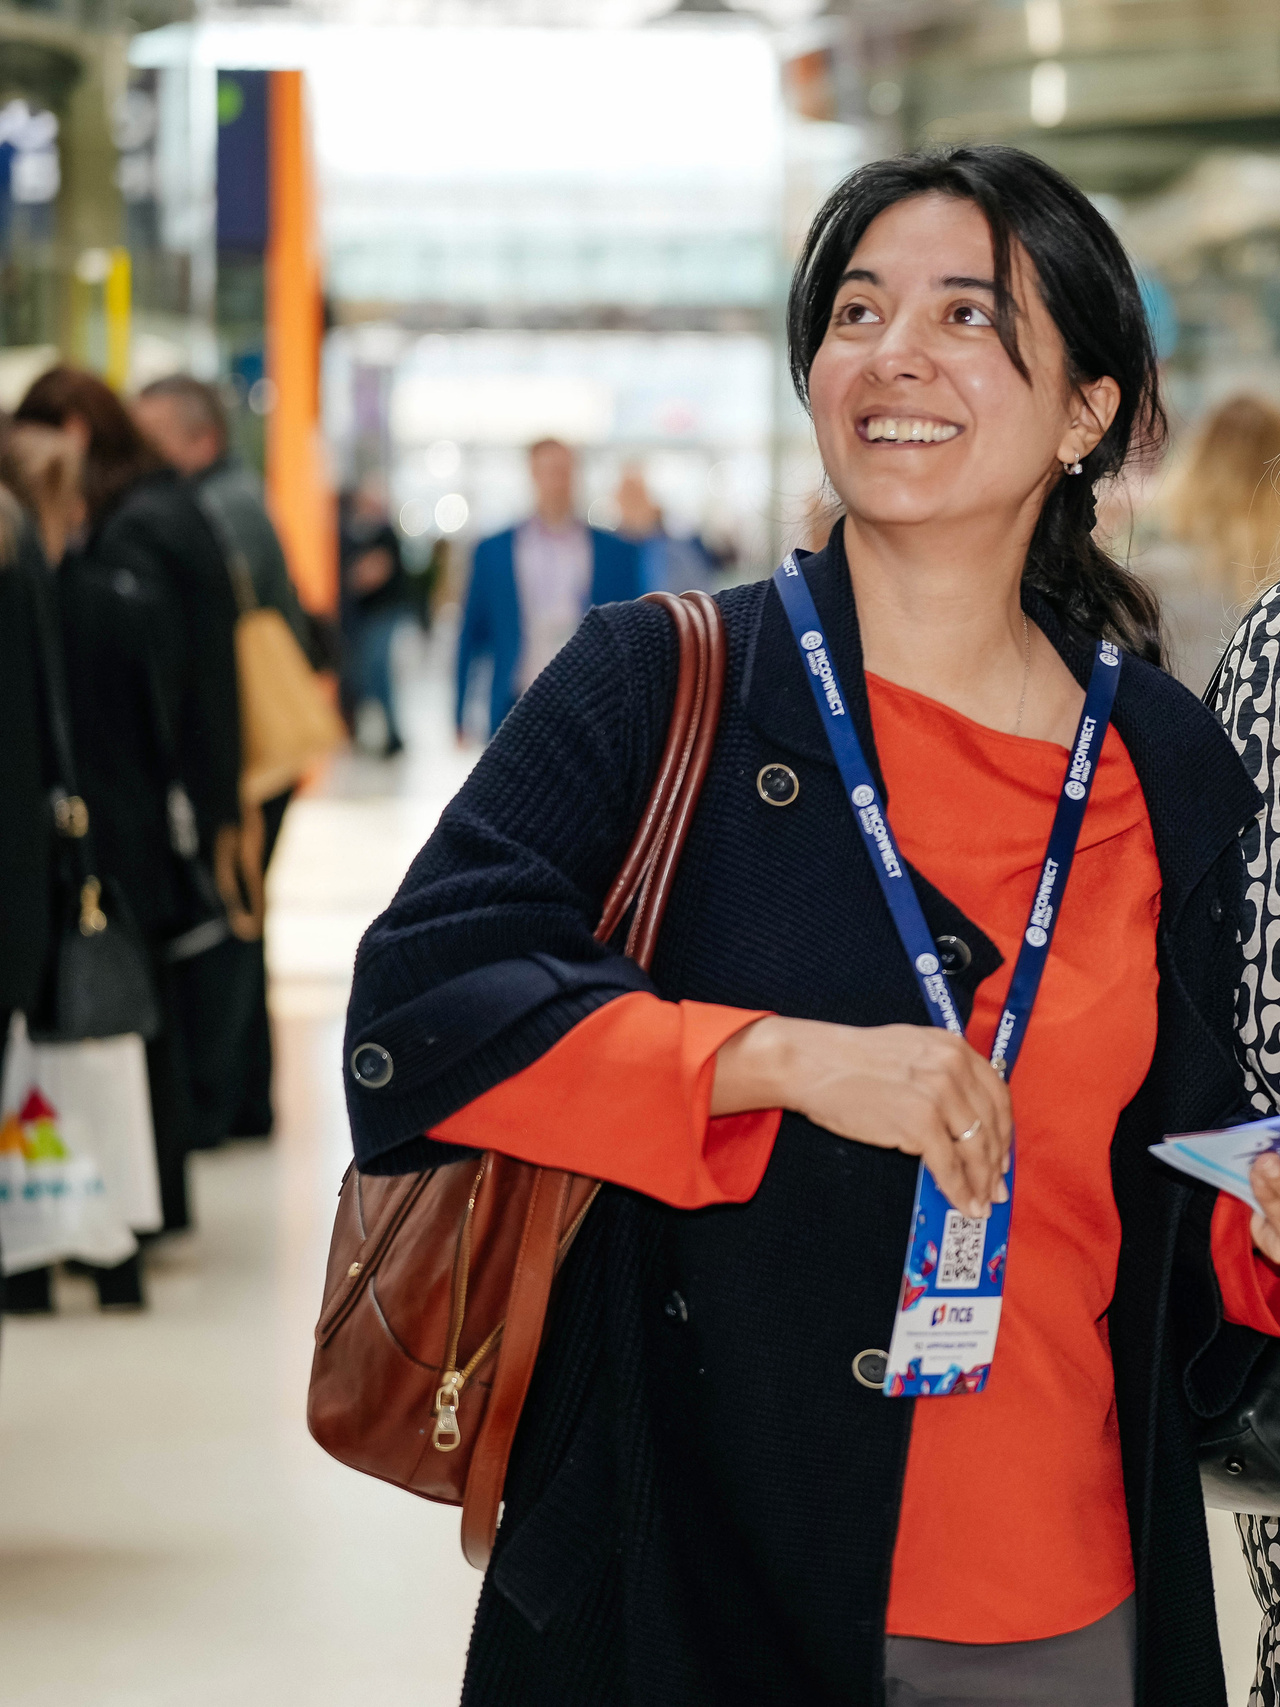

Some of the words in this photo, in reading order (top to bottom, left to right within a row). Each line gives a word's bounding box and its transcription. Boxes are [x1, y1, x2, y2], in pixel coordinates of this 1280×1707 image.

[814, 648, 845, 717] INCONNECT
[1069, 715, 1097, 780] INCONNECT
[866, 804, 903, 878] INCONNECT
[1030, 857, 1059, 927] INCONNECT
